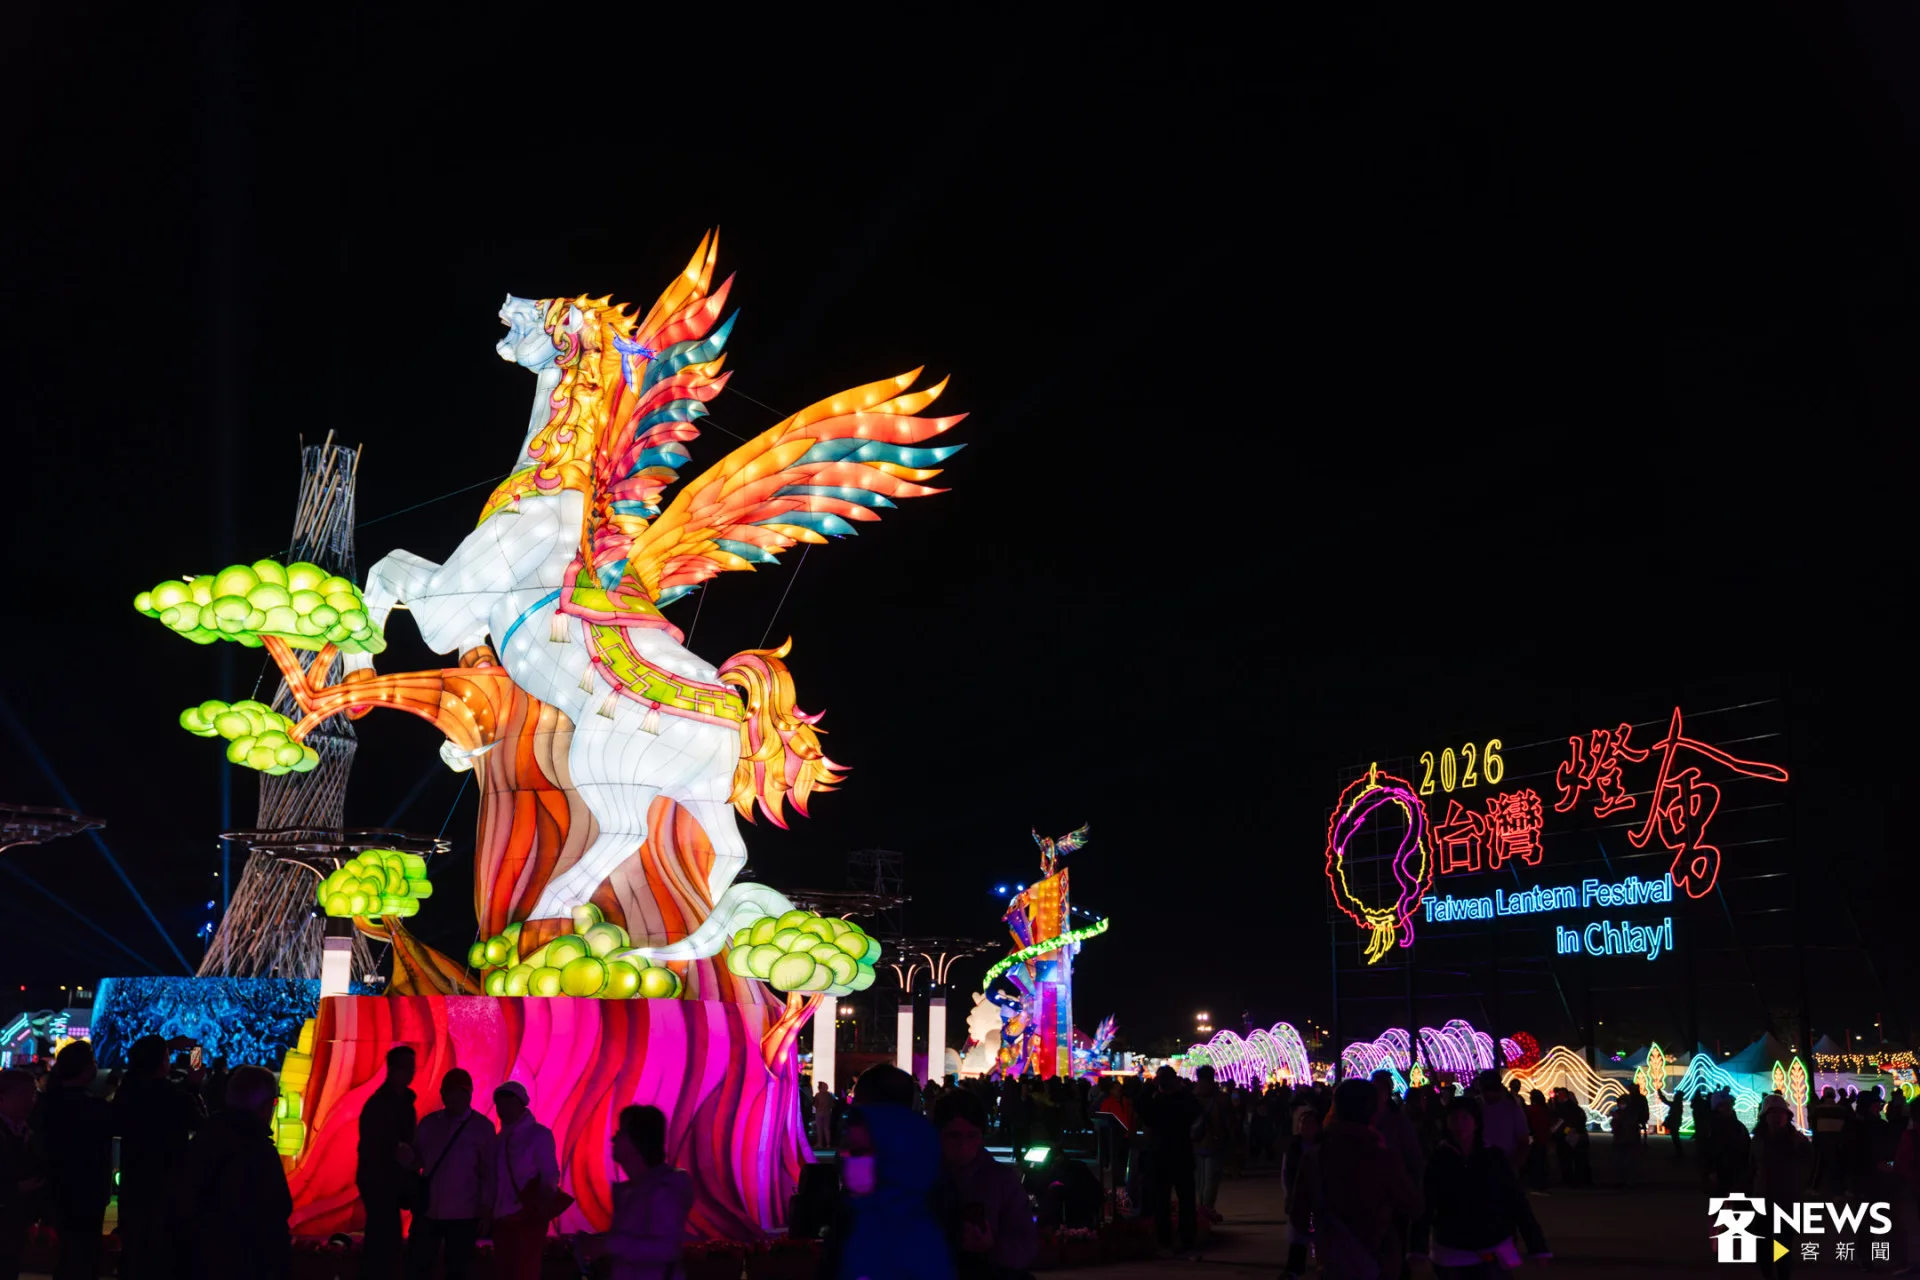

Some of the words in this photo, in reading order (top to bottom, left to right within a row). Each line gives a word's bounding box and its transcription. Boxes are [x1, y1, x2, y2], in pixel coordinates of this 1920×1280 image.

[1420, 738, 1504, 795] 2026
[1421, 894, 1494, 922] Taiwan
[1495, 885, 1577, 916] Lantern
[1582, 872, 1674, 907] Festival
[1556, 926, 1580, 954] in
[1583, 917, 1673, 960] Chiayi
